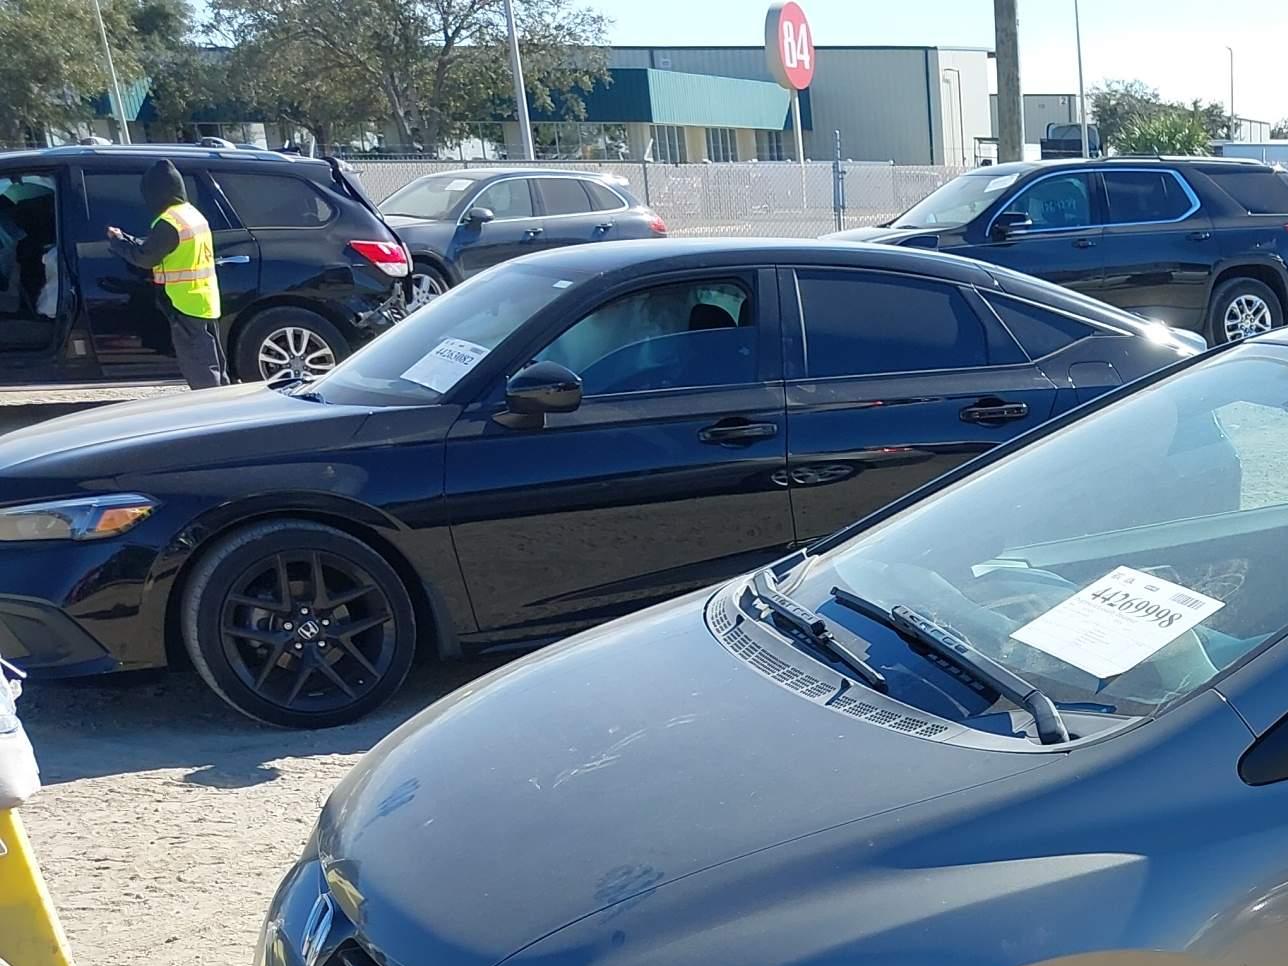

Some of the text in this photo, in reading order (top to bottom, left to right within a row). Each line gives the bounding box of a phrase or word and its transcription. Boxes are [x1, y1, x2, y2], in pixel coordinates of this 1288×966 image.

[783, 20, 811, 69] 84
[435, 347, 474, 365] 44263082
[1091, 587, 1182, 628] 44269998
